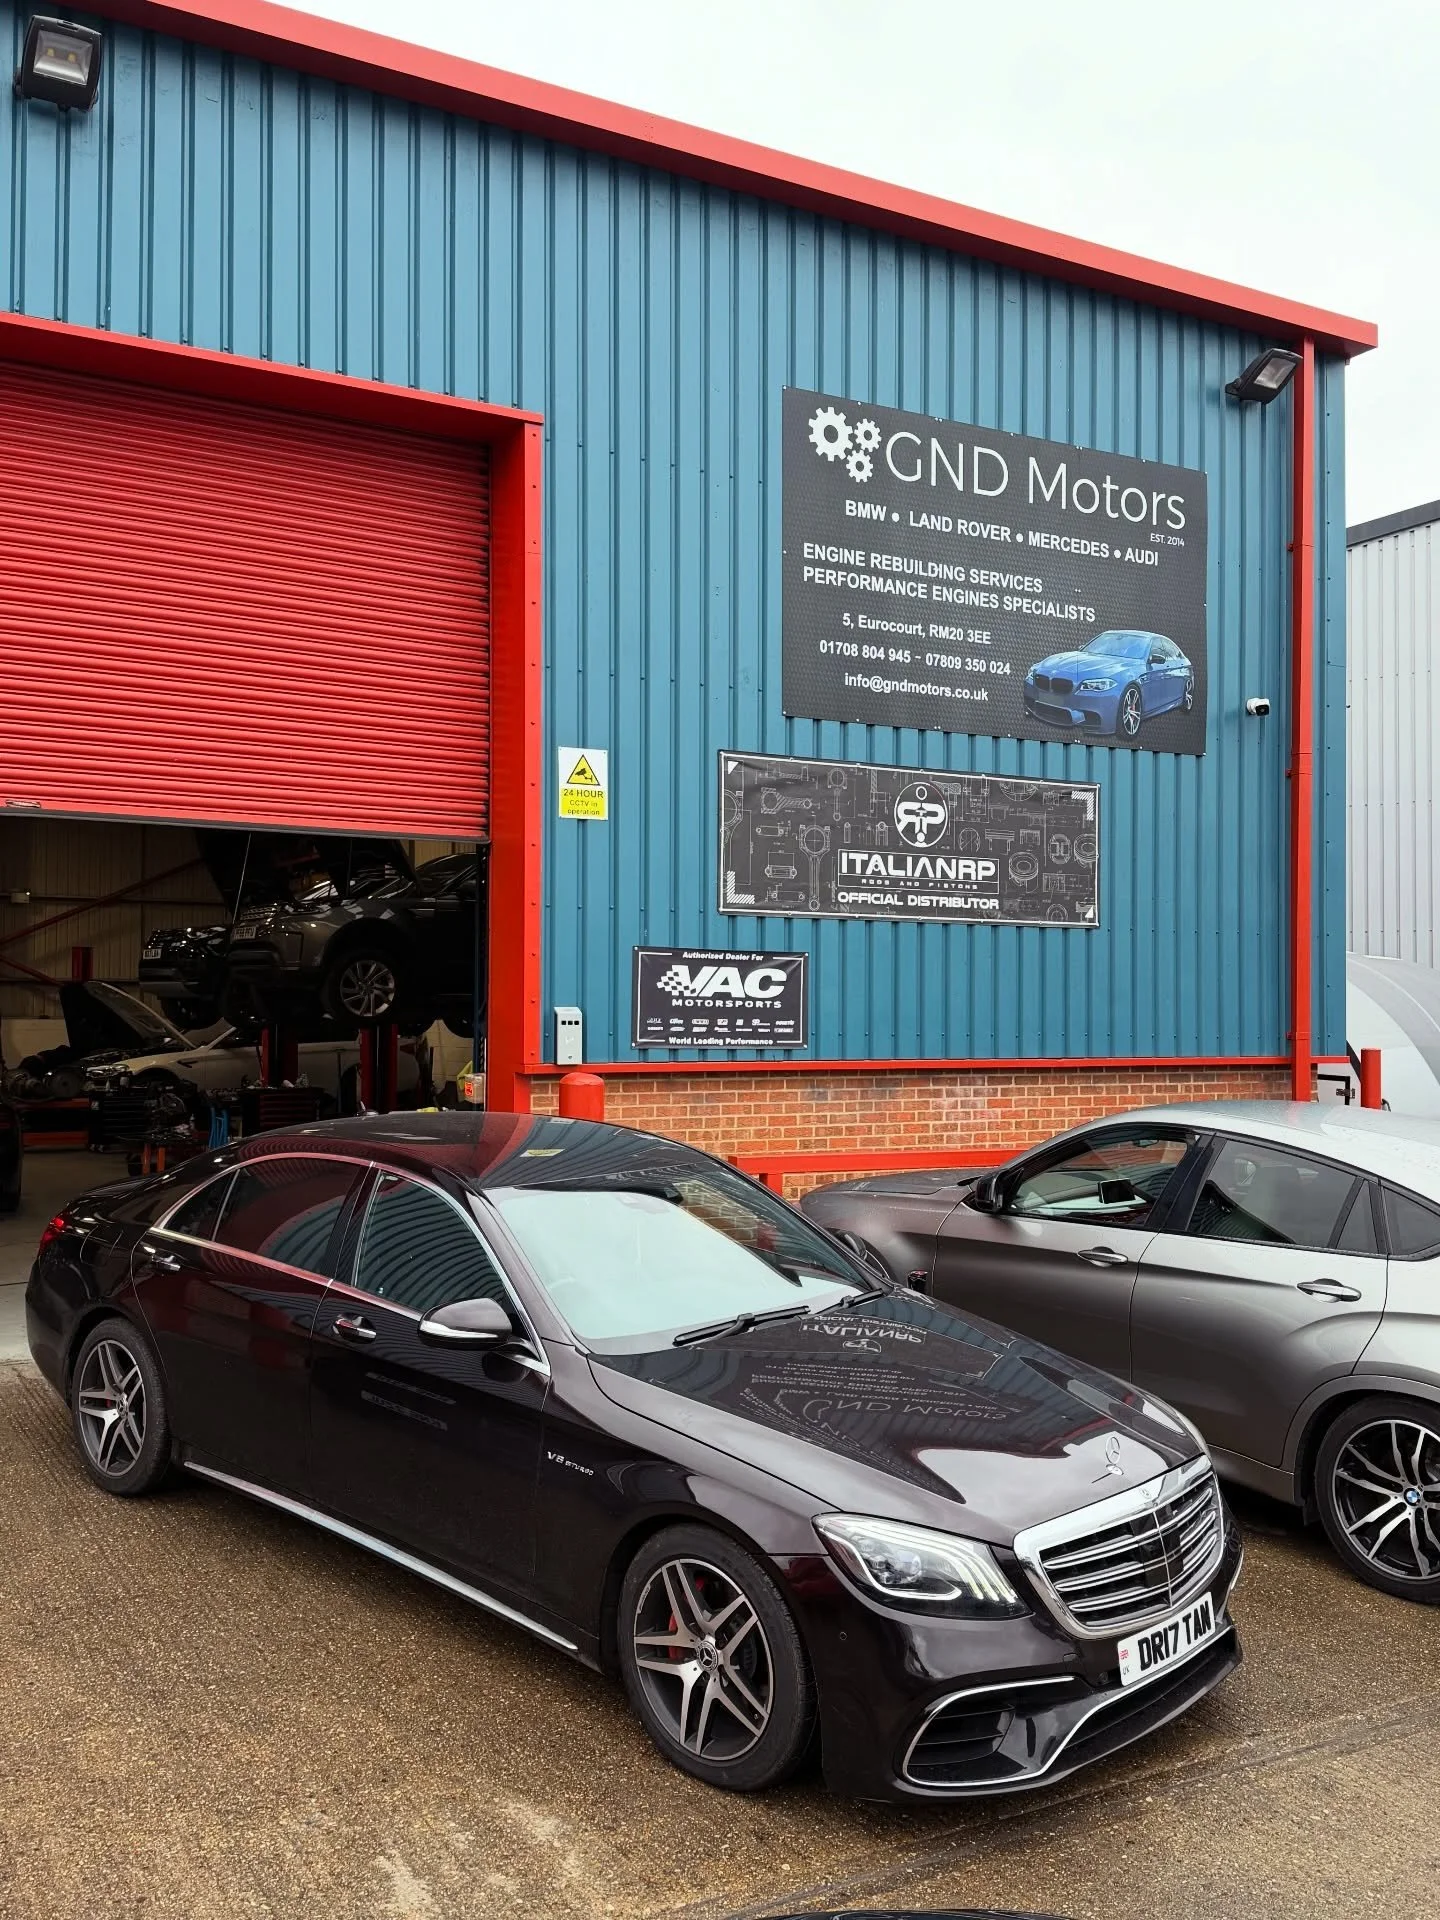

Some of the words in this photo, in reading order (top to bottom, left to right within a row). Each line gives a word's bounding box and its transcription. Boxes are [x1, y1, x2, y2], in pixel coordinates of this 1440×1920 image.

[886, 432, 1009, 497] GND
[1029, 457, 1186, 530] Motors
[845, 500, 887, 522] BMW
[909, 511, 953, 533] LAND
[957, 519, 1012, 543] ROVER
[1028, 531, 1110, 558] MERCEDES
[1125, 547, 1159, 566] AUDI
[1150, 533, 1166, 545] EST.
[1167, 535, 1185, 547] 2014
[803, 543, 866, 568] ENGINE
[870, 553, 966, 582] REBUILDING
[969, 569, 1043, 594] SERVICES
[803, 566, 928, 600] PERFORMANCE
[932, 586, 999, 610] ENGINES
[1003, 596, 1096, 622] SPECIALISTS
[842, 613, 855, 629] 5,
[858, 615, 926, 640] Eurocourt,
[929, 624, 964, 642] RM20
[967, 629, 991, 645] 3EE
[819, 639, 858, 658] 01708
[862, 645, 885, 661] 804
[888, 647, 911, 663] 945
[925, 653, 962, 671] 07809
[965, 657, 987, 673] 350
[989, 661, 1011, 676] 024
[844, 673, 989, 702] info@gndmotors.co.uk
[563, 788, 574, 796] 24
[576, 789, 604, 798] HOUR
[841, 852, 996, 881] ITALIANRP
[837, 891, 904, 907] OFFICIAL
[907, 894, 1000, 910] DISTRIBUTOR
[725, 953, 750, 961] Dealer
[670, 965, 788, 998] VAC
[671, 999, 782, 1009] MOTORSPORTS
[668, 1037, 692, 1045] World
[725, 1037, 774, 1046] Performance
[1182, 1601, 1211, 1645] TAN
